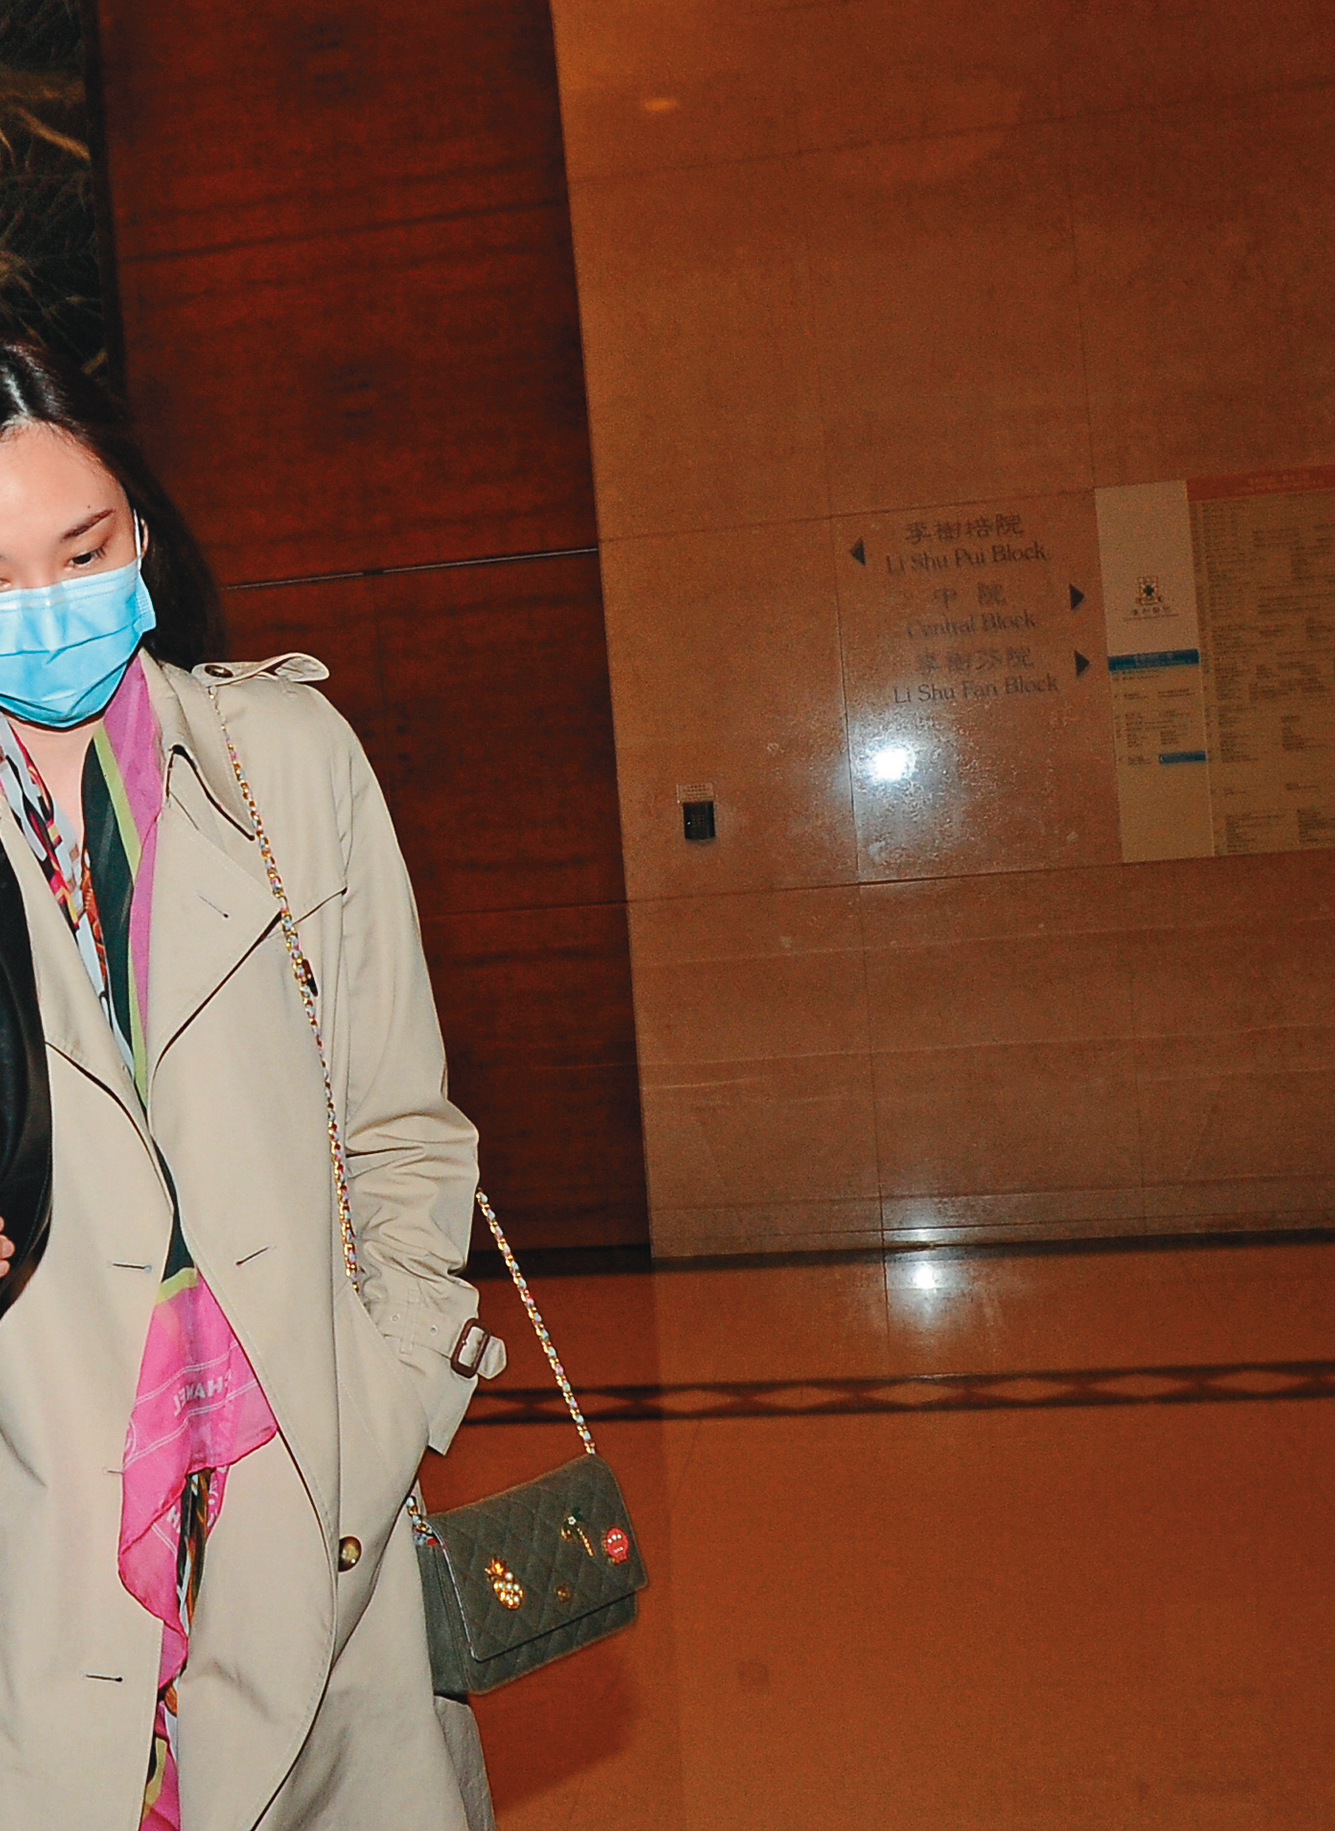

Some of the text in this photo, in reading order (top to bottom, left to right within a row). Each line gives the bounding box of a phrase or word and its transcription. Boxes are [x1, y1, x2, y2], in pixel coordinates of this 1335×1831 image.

[886, 541, 1048, 573] Li Shu Pui Block
[981, 609, 1036, 632] Block
[893, 673, 1058, 704] Li Shu Fan Block
